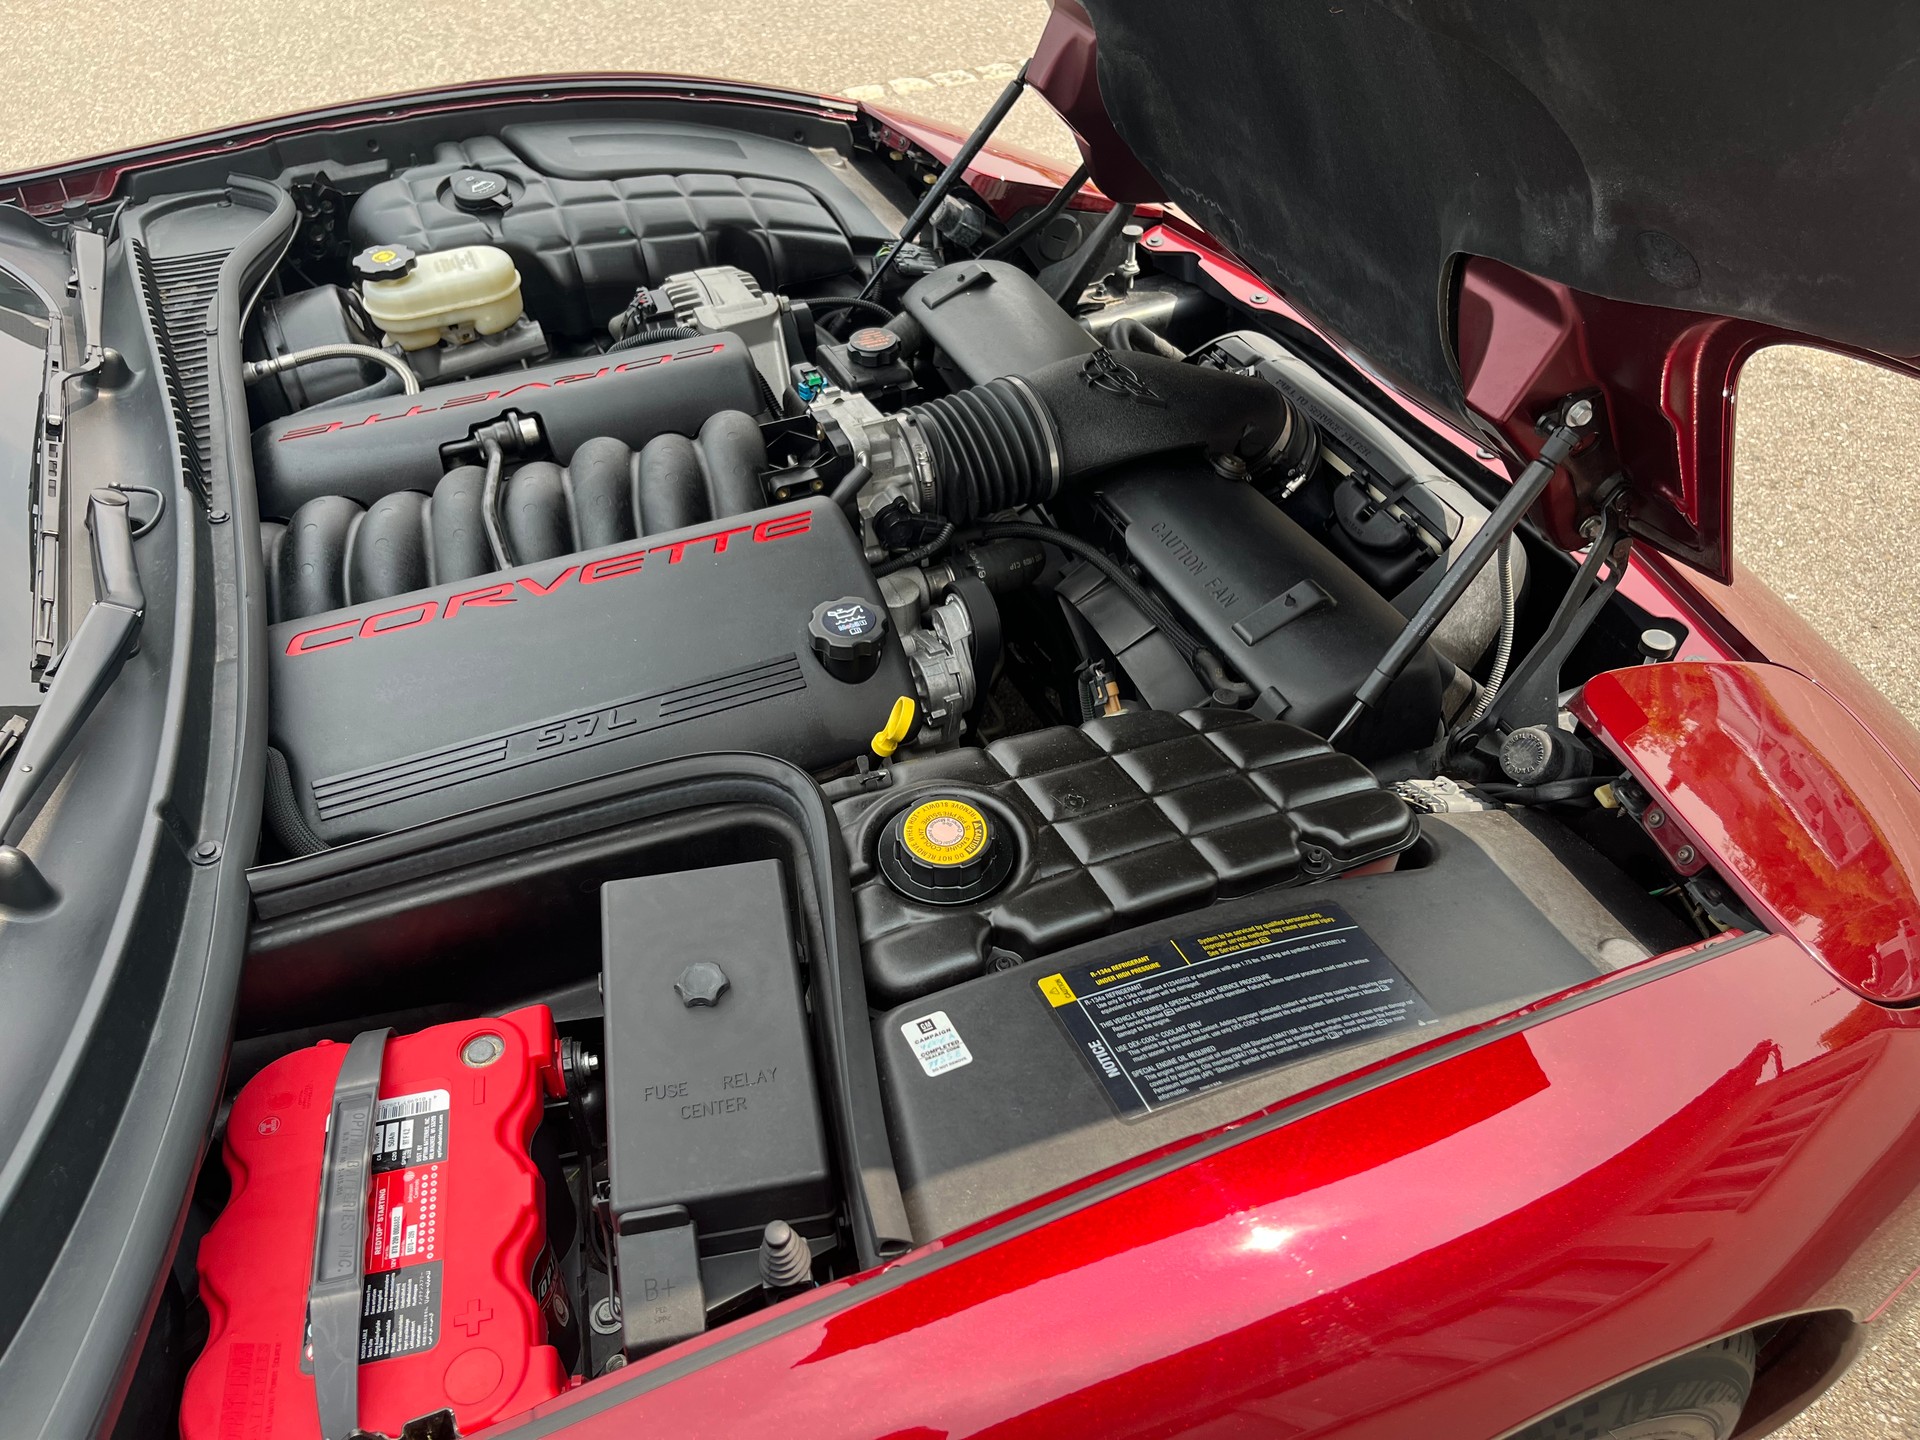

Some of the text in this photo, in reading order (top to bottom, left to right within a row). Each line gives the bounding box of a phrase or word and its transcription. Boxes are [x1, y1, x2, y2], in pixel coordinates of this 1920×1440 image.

[279, 344, 725, 442] CORVETTE
[1151, 522, 1240, 609] CAUTION FAN
[286, 510, 813, 656] CORVETTE
[536, 709, 637, 750] 5.7L
[922, 802, 976, 817] REMOVE SLOWLY
[911, 843, 935, 859] REMOVE
[918, 828, 969, 852] ENGINE COOLANT
[966, 829, 982, 853] CAUTION
[1089, 955, 1150, 977] R-134a REFRIGERANT
[1095, 961, 1160, 985] UNDER HIGH PRESSURE
[1056, 978, 1071, 998] CAUTION
[913, 1028, 951, 1044] CAMPAIGN
[920, 1039, 960, 1057] COMPLETED
[1087, 1038, 1120, 1079] NOTICE
[644, 1067, 777, 1101] FUSE RELAY
[681, 1097, 748, 1120] CENTER
[377, 1188, 385, 1222] STARTING
[336, 1244, 353, 1272] INC.
